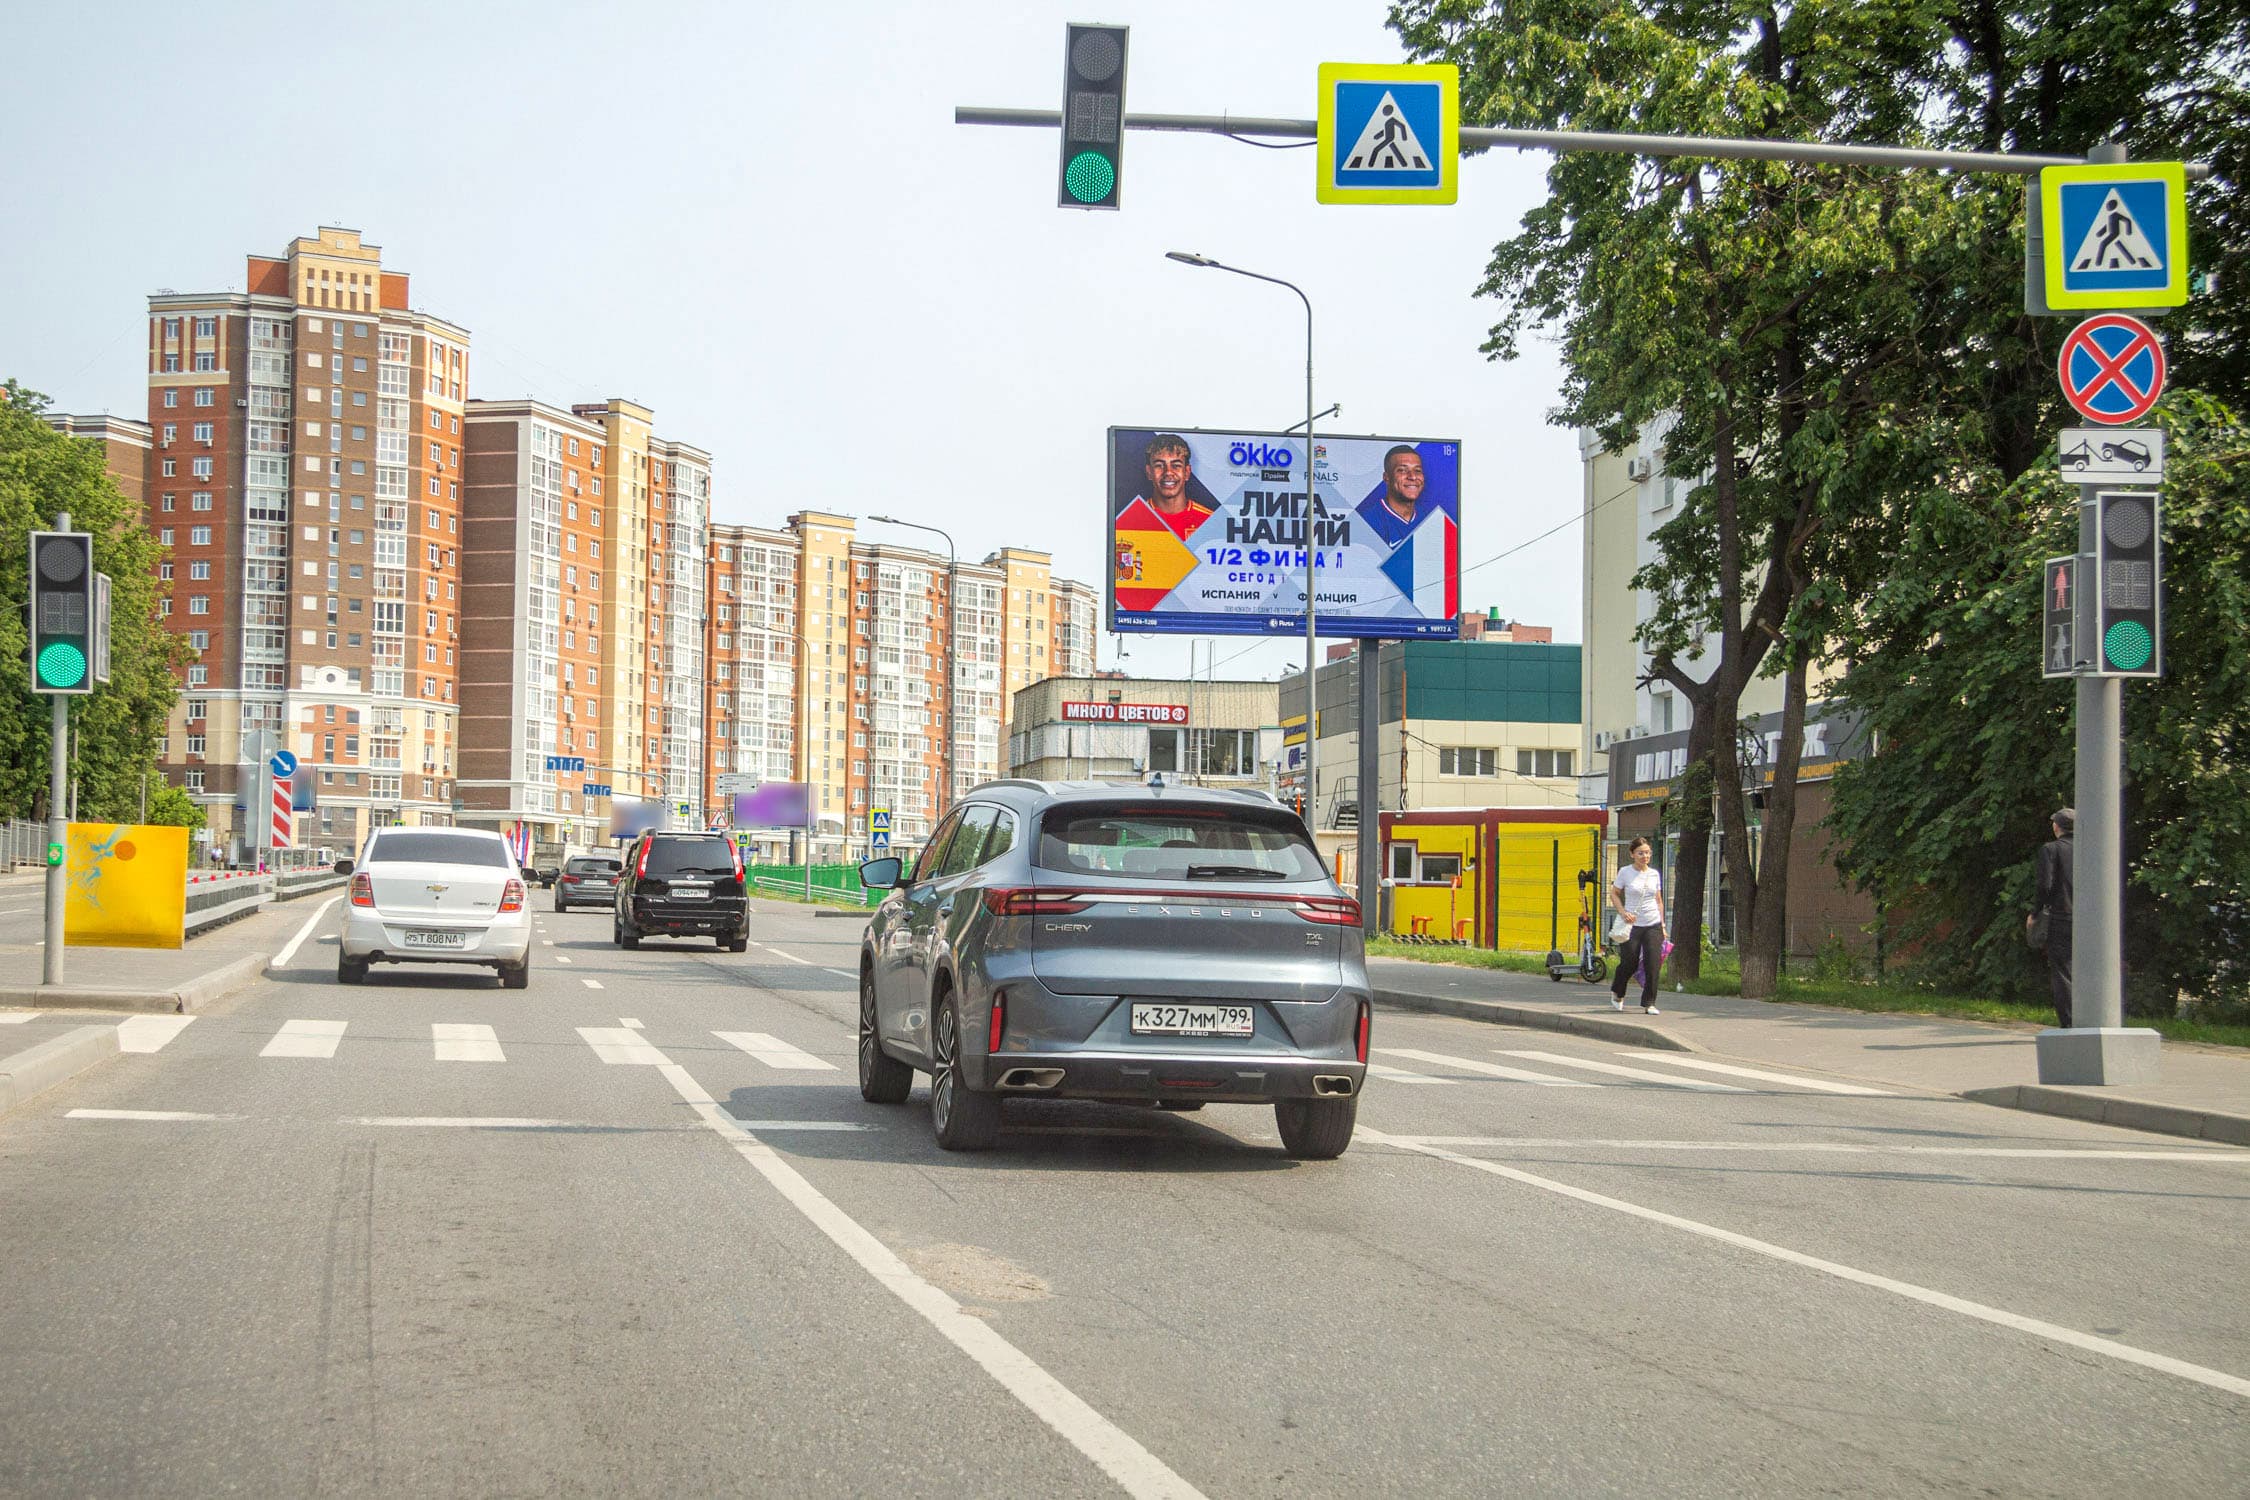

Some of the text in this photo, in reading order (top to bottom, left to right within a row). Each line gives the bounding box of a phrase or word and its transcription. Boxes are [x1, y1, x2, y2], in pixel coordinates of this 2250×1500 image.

[1443, 445, 1456, 456] 18+
[1304, 471, 1339, 482] FNALS
[1240, 491, 1329, 519] ЛИГА
[1227, 514, 1350, 549] НАЦИЙ
[1207, 549, 1242, 565] 1/2
[1202, 590, 1260, 600] ИСПАНИЯ
[1298, 592, 1357, 603] ФАНЦИЯ
[1067, 704, 1114, 719] МНОГО
[1119, 706, 1170, 721] ЦВЕТОВ
[1128, 900, 1262, 917] EXEED
[1045, 923, 1092, 932] CHERY
[1219, 1008, 1248, 1024] 799
